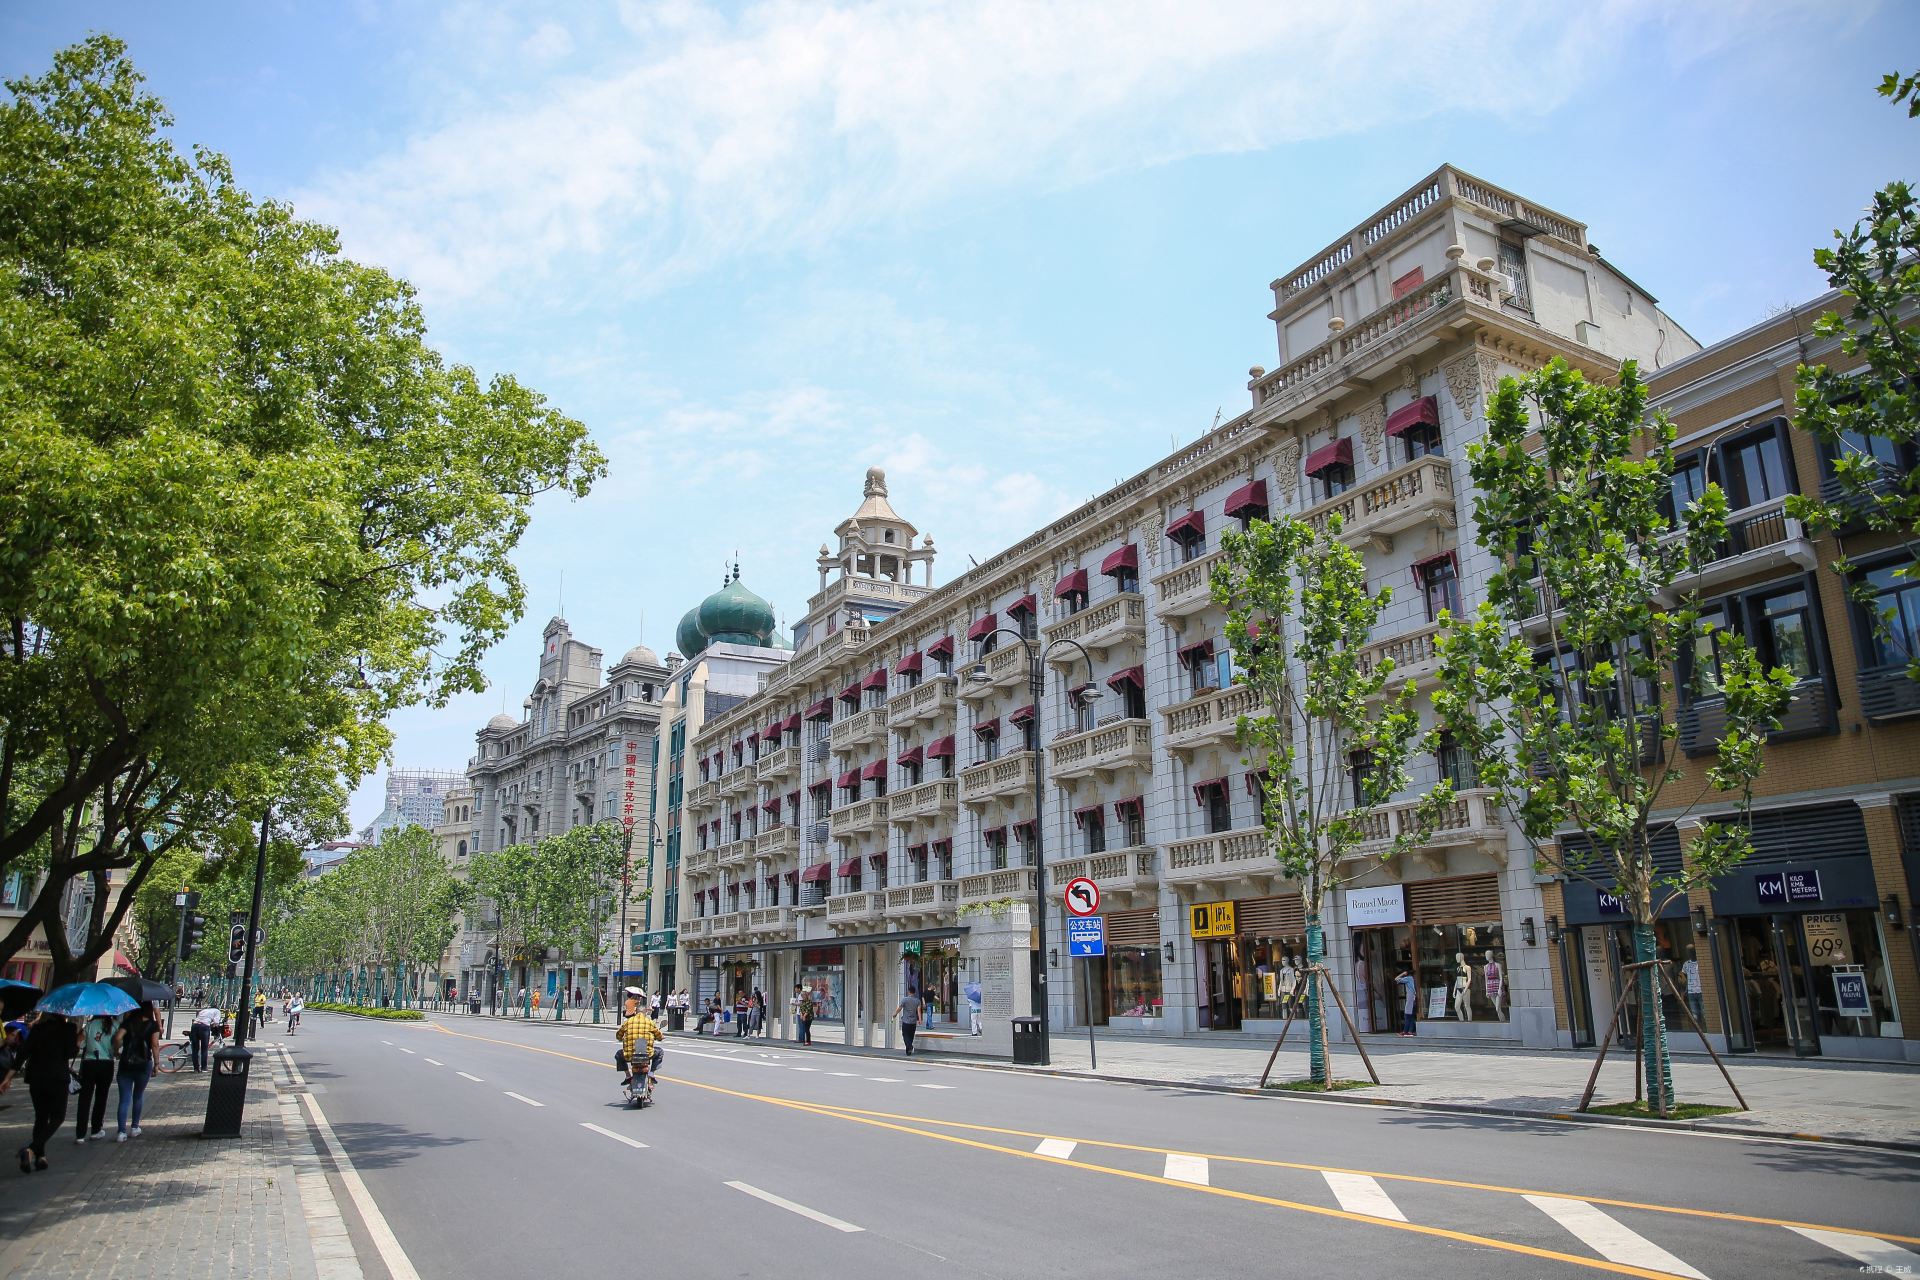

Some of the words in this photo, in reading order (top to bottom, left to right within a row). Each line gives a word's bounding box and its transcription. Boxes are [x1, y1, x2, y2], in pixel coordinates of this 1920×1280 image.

[1759, 880, 1783, 896] KM
[1791, 886, 1817, 894] METERS
[1599, 894, 1618, 907] KM
[1070, 919, 1101, 931] 公交车站
[1806, 914, 1842, 924] PRICES
[1215, 924, 1232, 932] HOME
[1841, 981, 1861, 993] NEW
